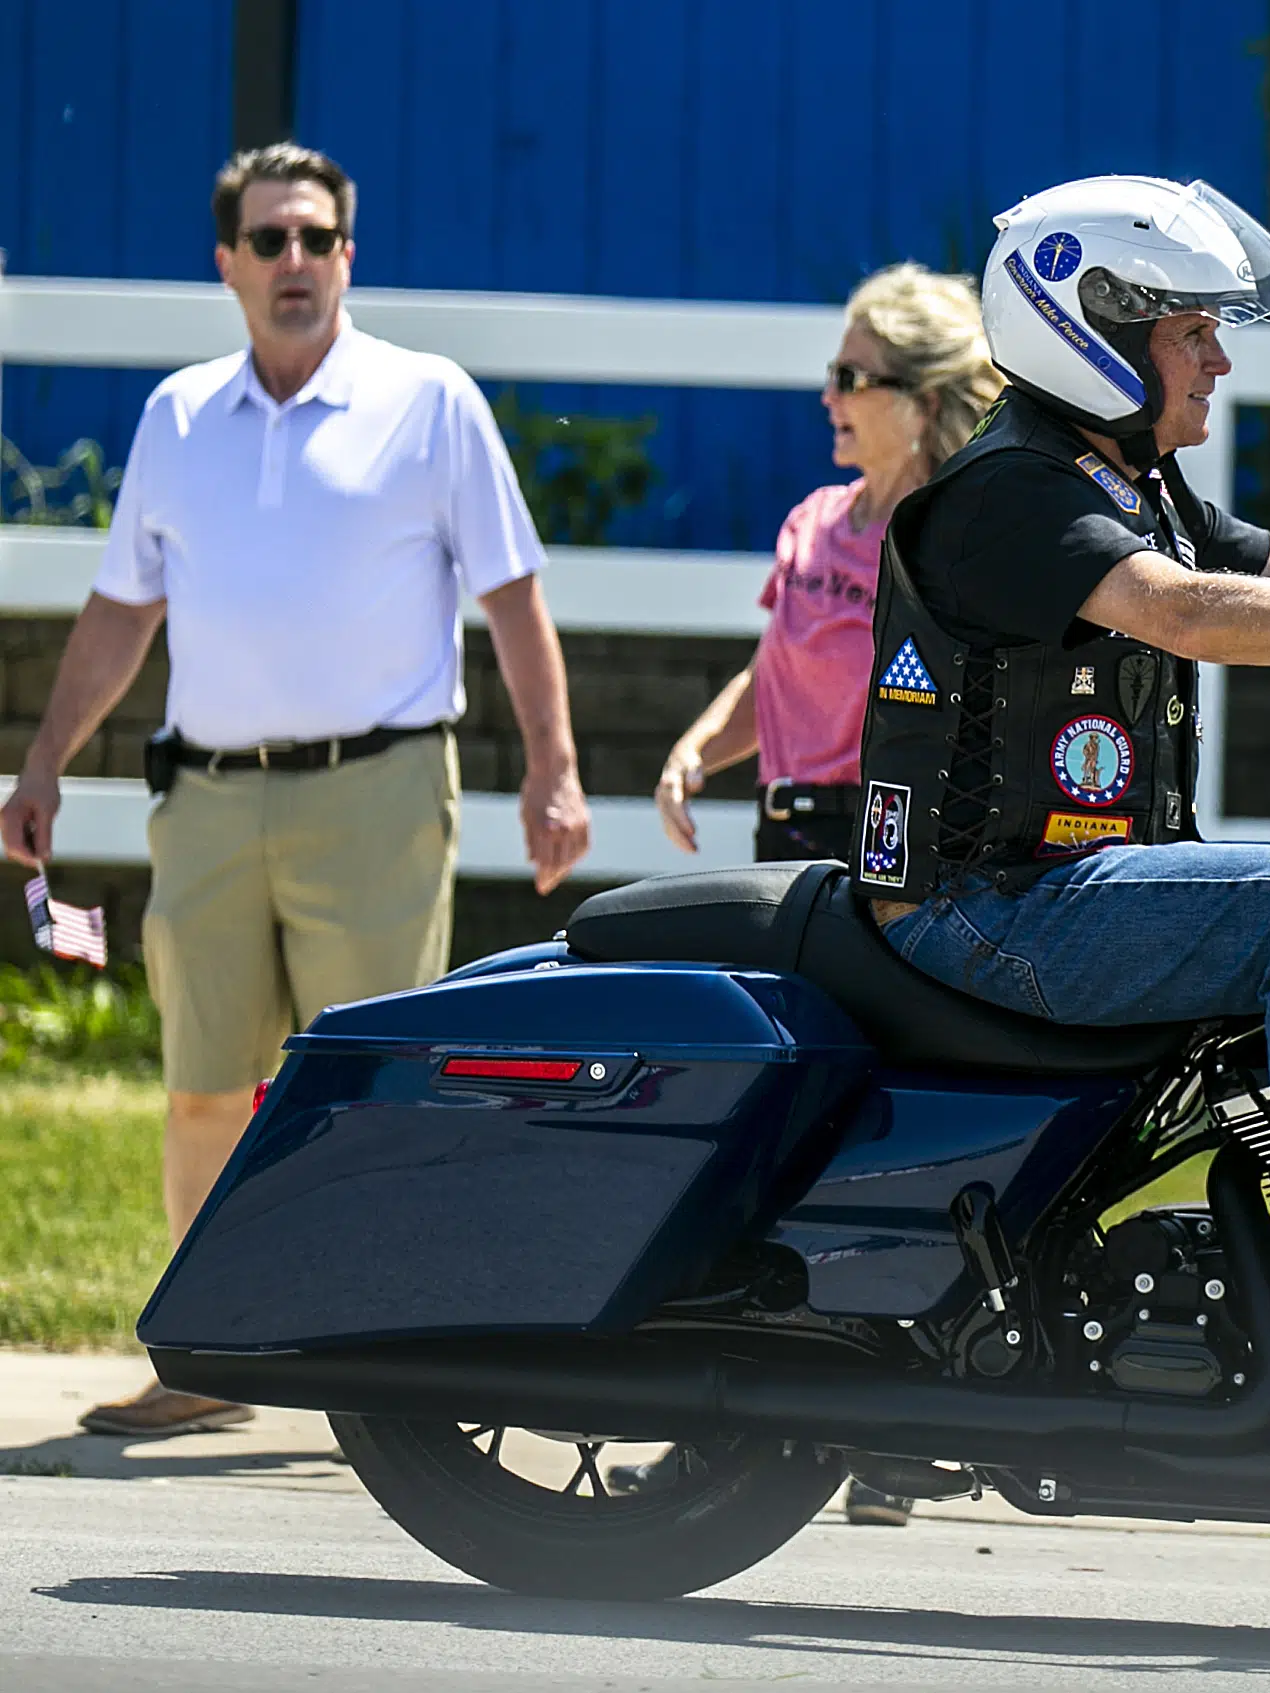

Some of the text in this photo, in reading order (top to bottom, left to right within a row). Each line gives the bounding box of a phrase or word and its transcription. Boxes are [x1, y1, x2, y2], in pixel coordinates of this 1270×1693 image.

[1007, 258, 1089, 350] Governor Mike Pence
[879, 686, 936, 705] IN MEMORIAM
[1054, 718, 1131, 774] ARMY NATIONAL GUARD
[1057, 818, 1118, 832] INDIANA
